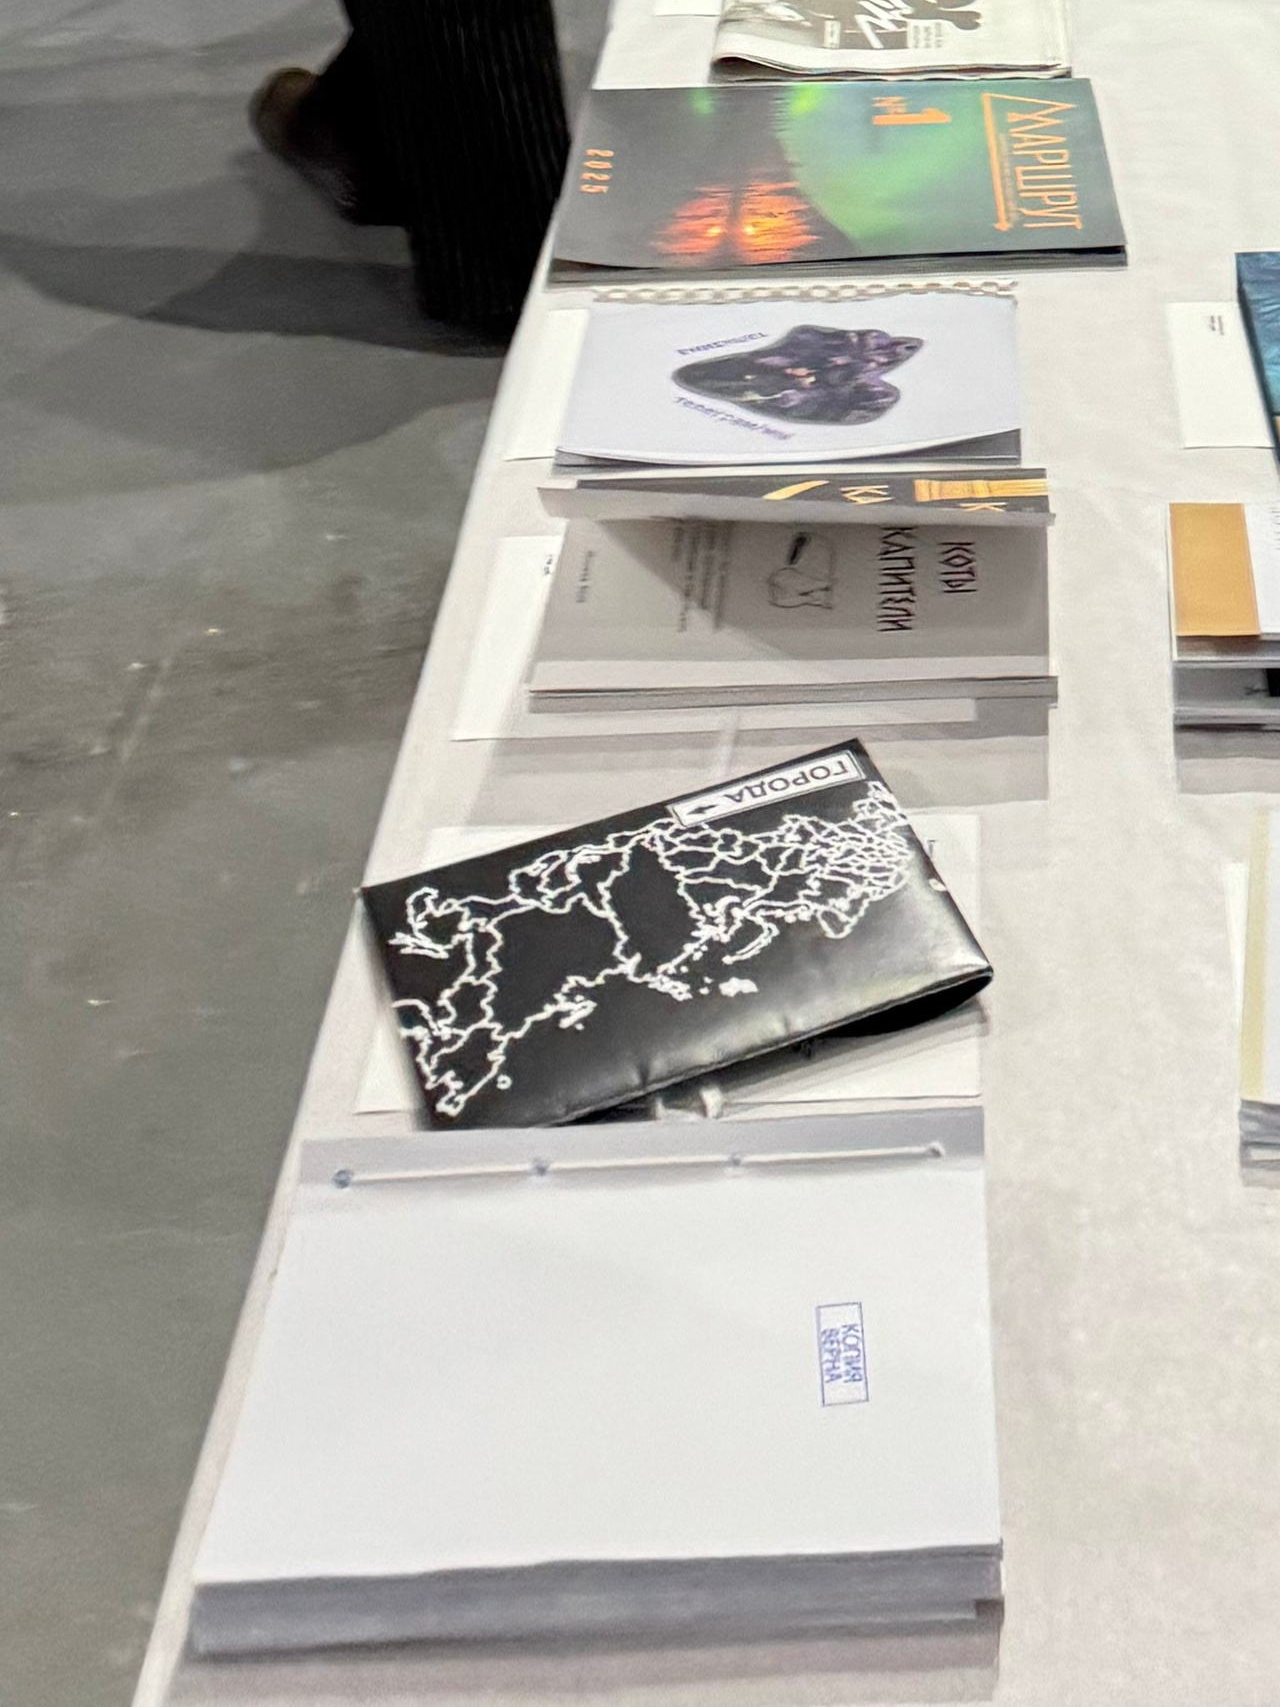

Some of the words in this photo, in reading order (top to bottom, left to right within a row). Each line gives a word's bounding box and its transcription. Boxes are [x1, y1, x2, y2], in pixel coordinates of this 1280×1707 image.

[580, 147, 614, 195] 2025
[877, 525, 918, 633] КАПИТЕЛИ
[938, 539, 979, 596] КОТЫ
[722, 753, 851, 806] ГОРОДА
[841, 1323, 863, 1383] КОПИЯ
